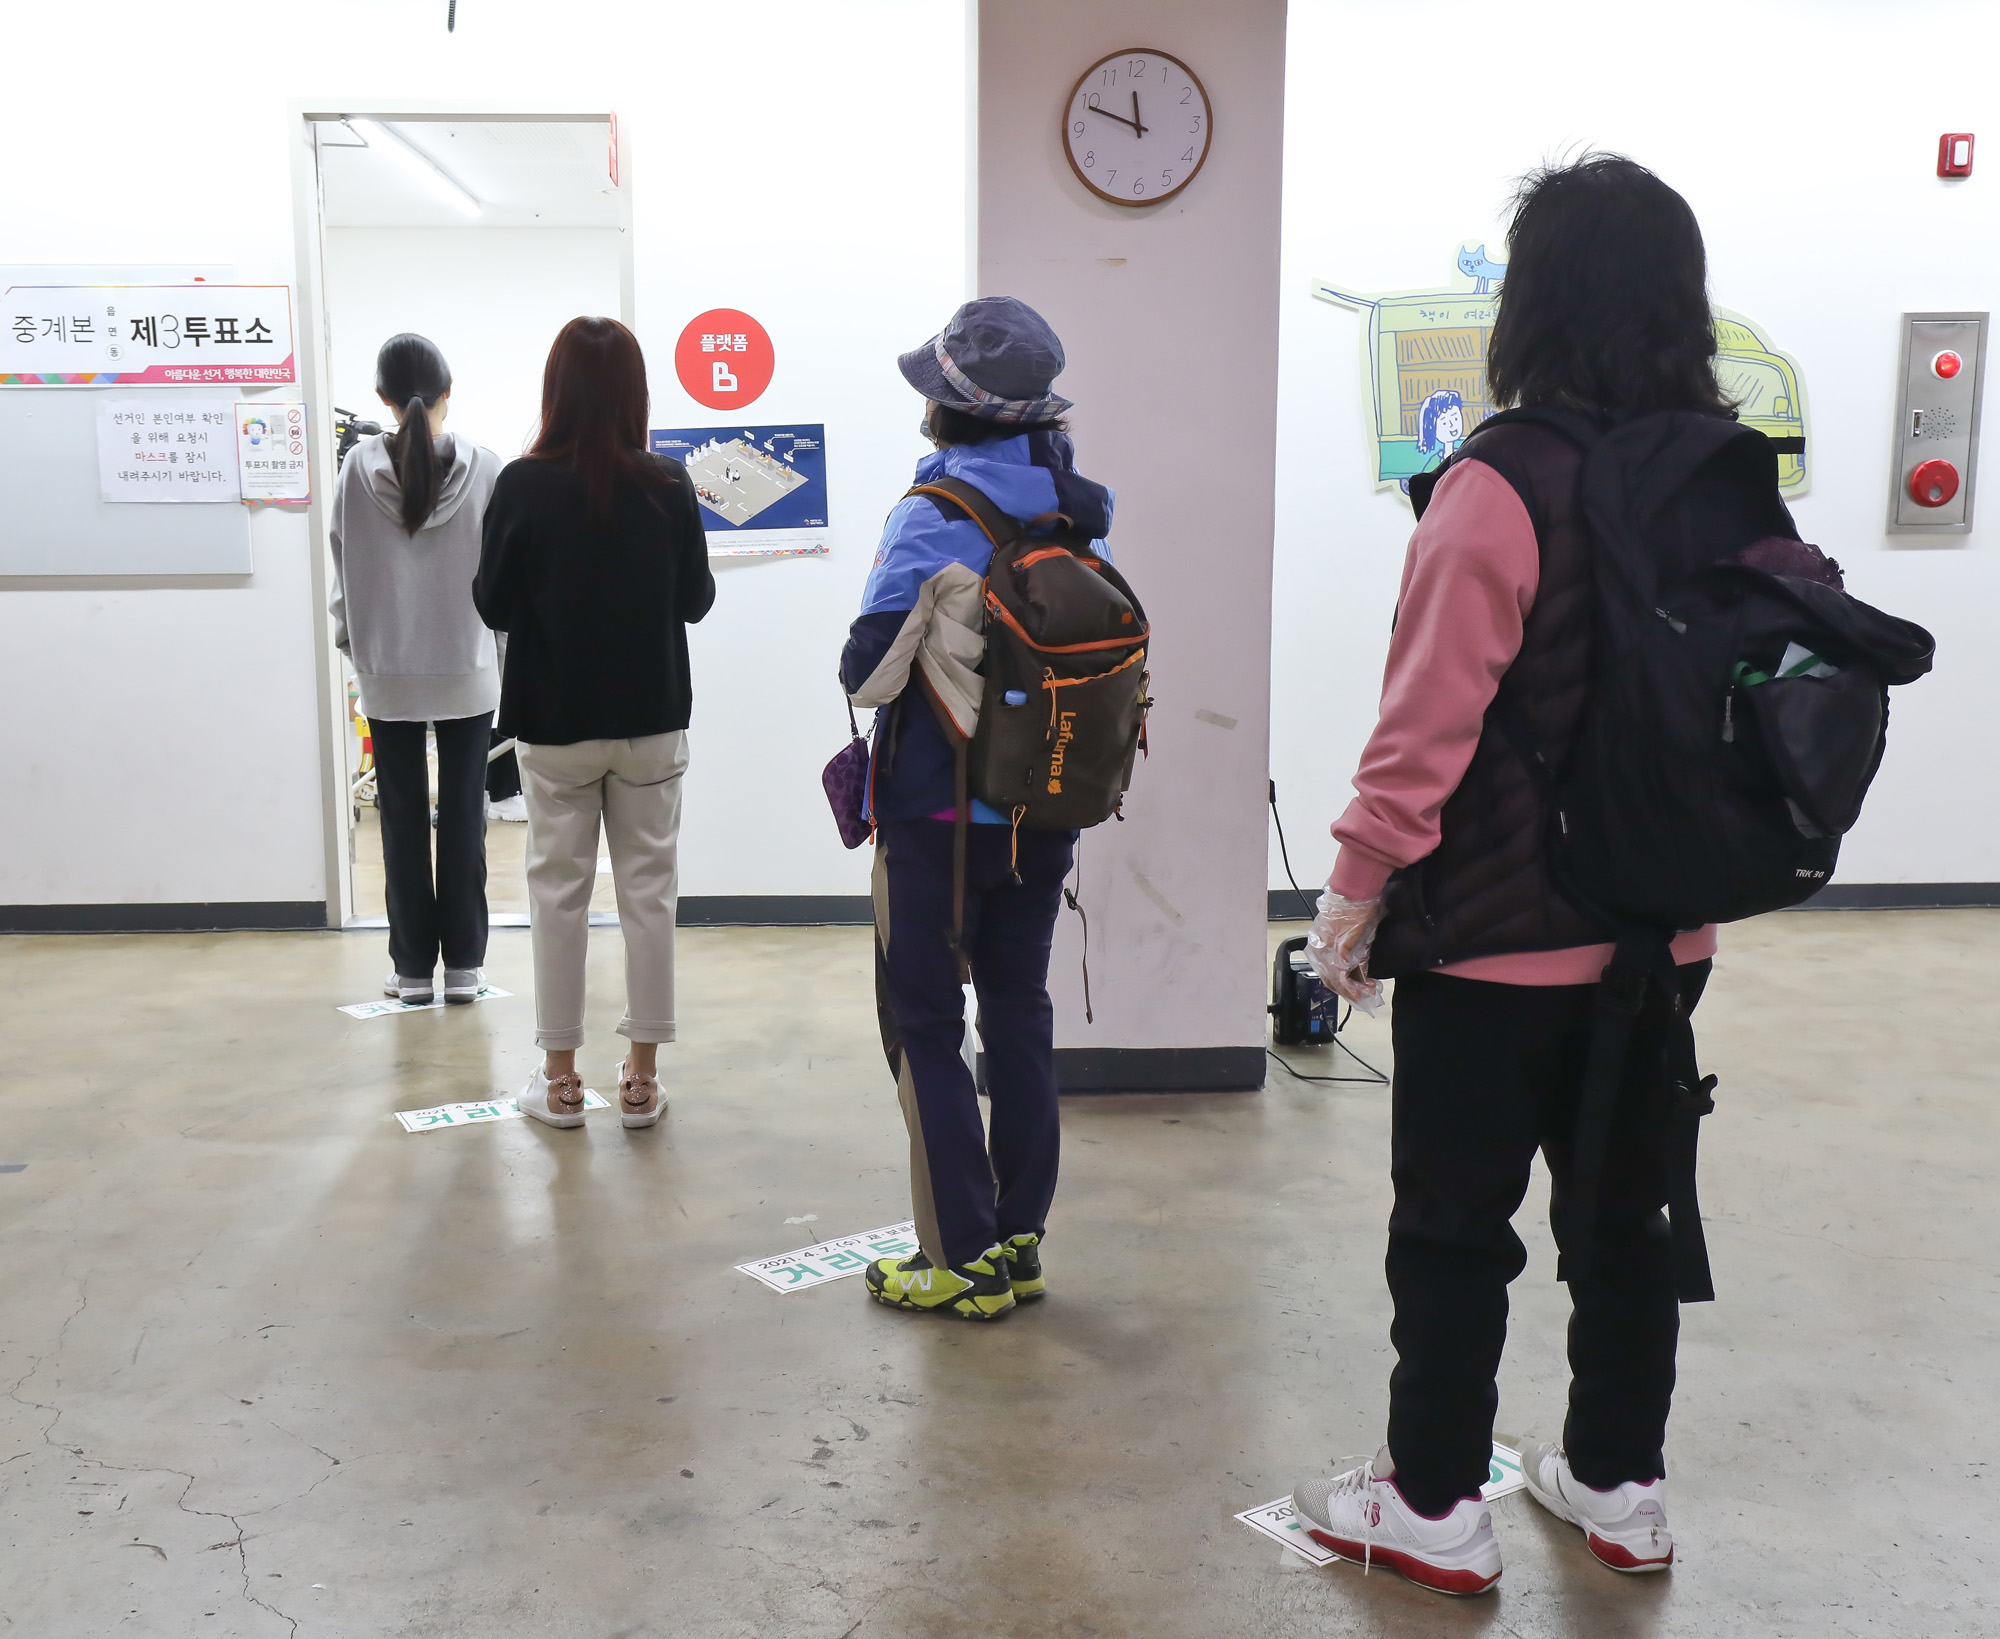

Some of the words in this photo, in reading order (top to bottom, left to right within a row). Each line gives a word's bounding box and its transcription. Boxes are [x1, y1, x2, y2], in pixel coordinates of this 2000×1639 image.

[1128, 59, 1146, 78] 12
[1162, 67, 1168, 84] 1
[1102, 69, 1117, 87] 11
[1082, 92, 1101, 110] 10
[1179, 86, 1192, 105] 2
[1073, 121, 1085, 139] 9
[1189, 115, 1201, 134] 3
[1084, 150, 1096, 168] 8
[1181, 146, 1194, 163] 4
[1106, 169, 1117, 187] 7
[1133, 177, 1145, 195] 6
[1161, 169, 1174, 187] 5
[1419, 309, 1450, 323] 책이
[12, 315, 96, 344] 중계본
[130, 314, 274, 349] 제3투표소
[699, 333, 749, 352] 플랫폼
[164, 368, 201, 381] 아름다운
[203, 369, 224, 380] 선거,
[224, 368, 253, 380] 행복한
[254, 368, 291, 379] 대한민국
[113, 412, 145, 425] 선거인
[152, 412, 196, 425] 본인여부
[202, 412, 224, 425] 확인
[131, 432, 141, 444] 을
[147, 432, 169, 444] 위해
[176, 432, 208, 444] 요청시
[135, 451, 178, 463] 마스크를
[185, 451, 206, 463] 잠시
[245, 460, 269, 470] 투표지
[289, 460, 304, 470] 금지
[118, 471, 172, 483] 내려주시기
[178, 471, 227, 483] 바랍니다.
[1049, 711, 1076, 777] Lafuma
[1795, 868, 1813, 878] TRK
[1812, 870, 1825, 879] 30
[864, 1225, 914, 1241] 재·보궐
[769, 1236, 918, 1284] 거리두
[1266, 1504, 1294, 1521] 20
